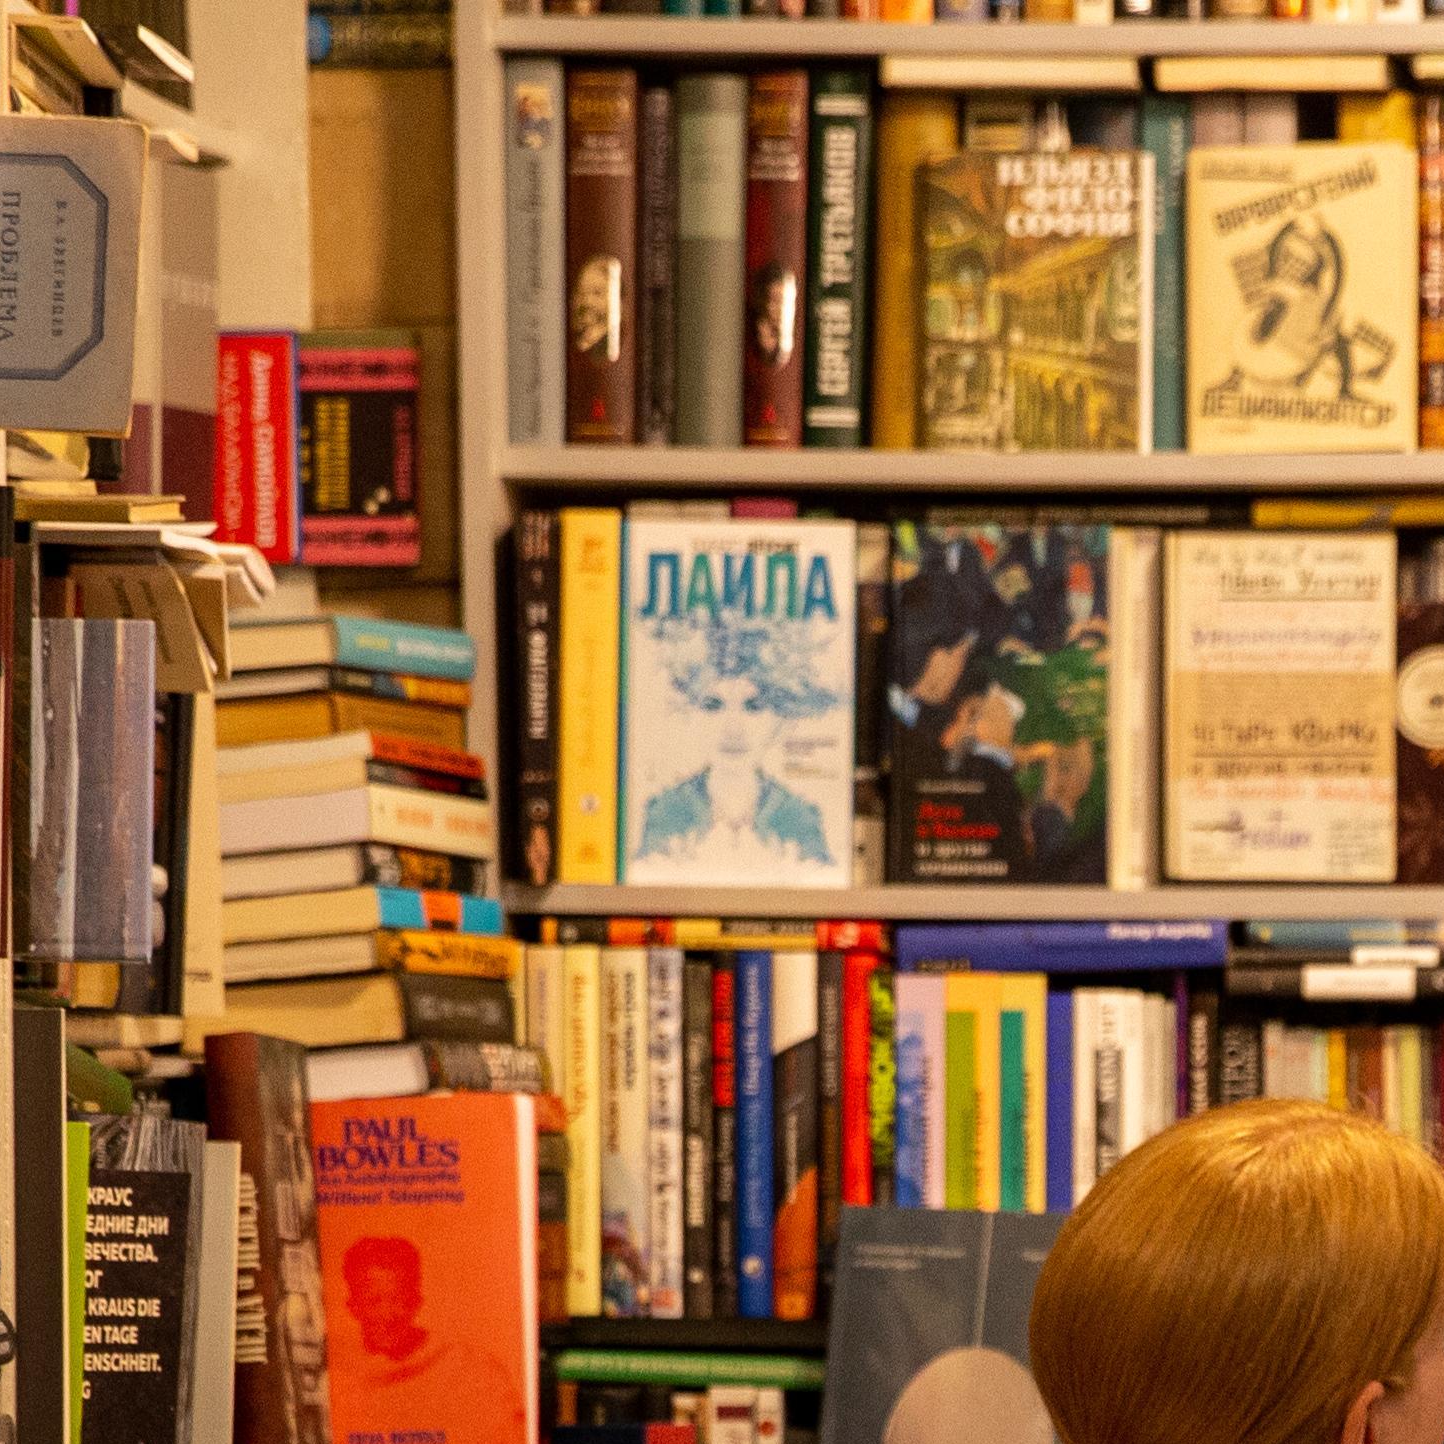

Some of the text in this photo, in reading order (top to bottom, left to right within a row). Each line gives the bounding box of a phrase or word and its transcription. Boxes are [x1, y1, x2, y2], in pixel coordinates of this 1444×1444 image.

[814, 125, 857, 397] СЕРГЕЙ ТРЕТЬЯКОВ
[342, 1117, 429, 1145] PAUL
[318, 1140, 461, 1171] BOWLES
[87, 1187, 133, 1208] КРАУС
[85, 1214, 170, 1238] ЕДНИЕ ДНИ
[88, 1298, 161, 1317] KRAUS DIE
[103, 1325, 139, 1345] TAGE
